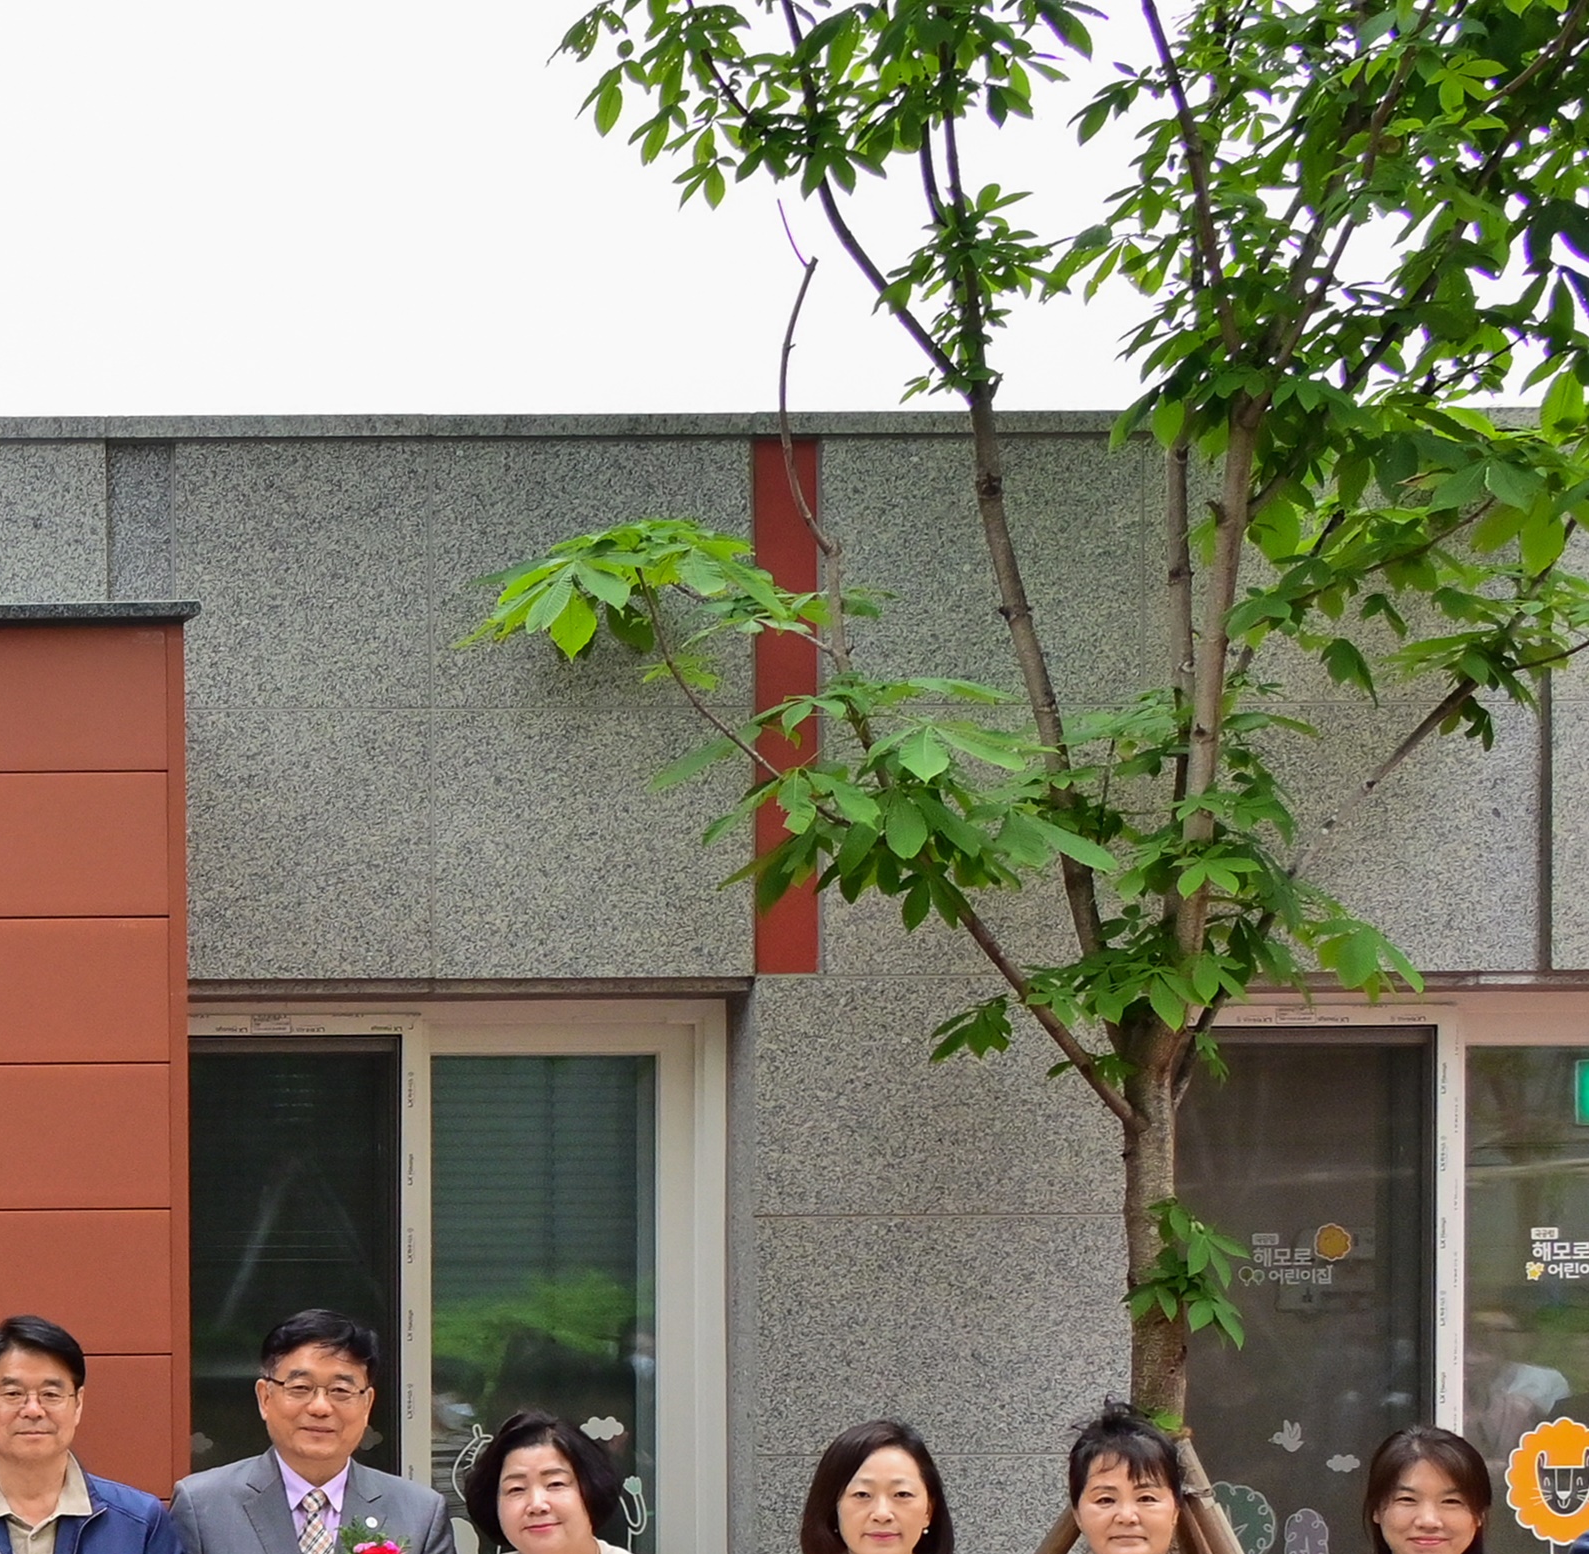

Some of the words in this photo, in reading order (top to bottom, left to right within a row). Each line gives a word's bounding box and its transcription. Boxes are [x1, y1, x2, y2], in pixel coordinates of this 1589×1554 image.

[1253, 1247, 1312, 1267] 해모로
[1532, 1241, 1589, 1261] 해모로
[1268, 1265, 1333, 1285] 어린이집
